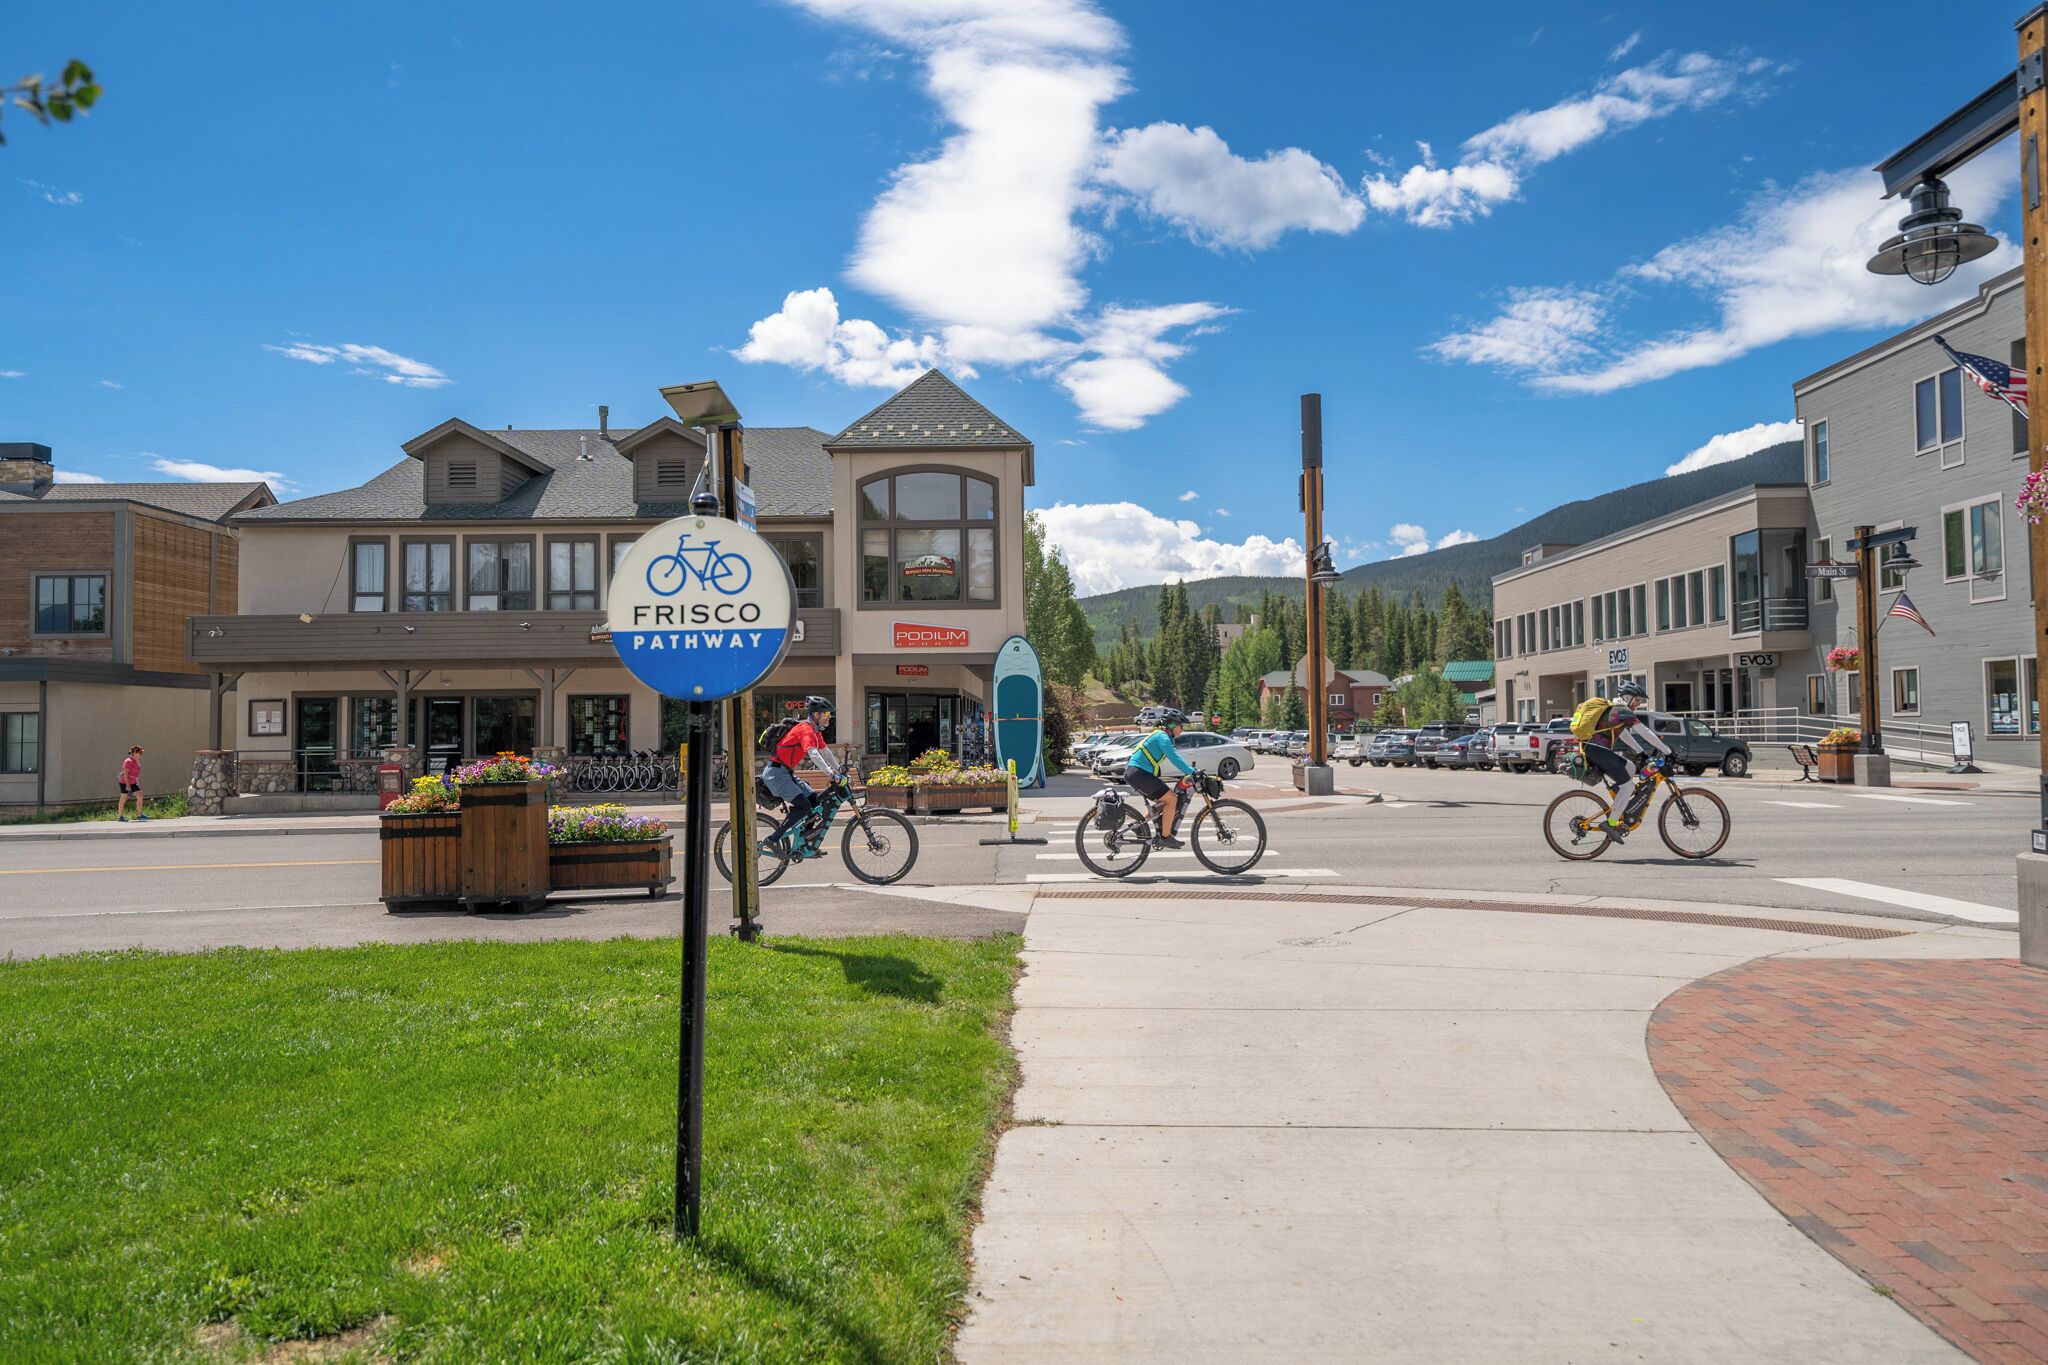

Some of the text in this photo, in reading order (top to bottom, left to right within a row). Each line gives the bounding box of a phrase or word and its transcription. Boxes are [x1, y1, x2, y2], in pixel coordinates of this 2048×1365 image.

[1818, 567, 1847, 576] Main St
[633, 603, 761, 626] FRISCO
[633, 632, 762, 650] PATHWAY
[896, 631, 966, 641] PODIUM
[1609, 648, 1627, 665] EVO3
[1740, 654, 1773, 666] EVO3
[899, 665, 928, 673] PODIUM
